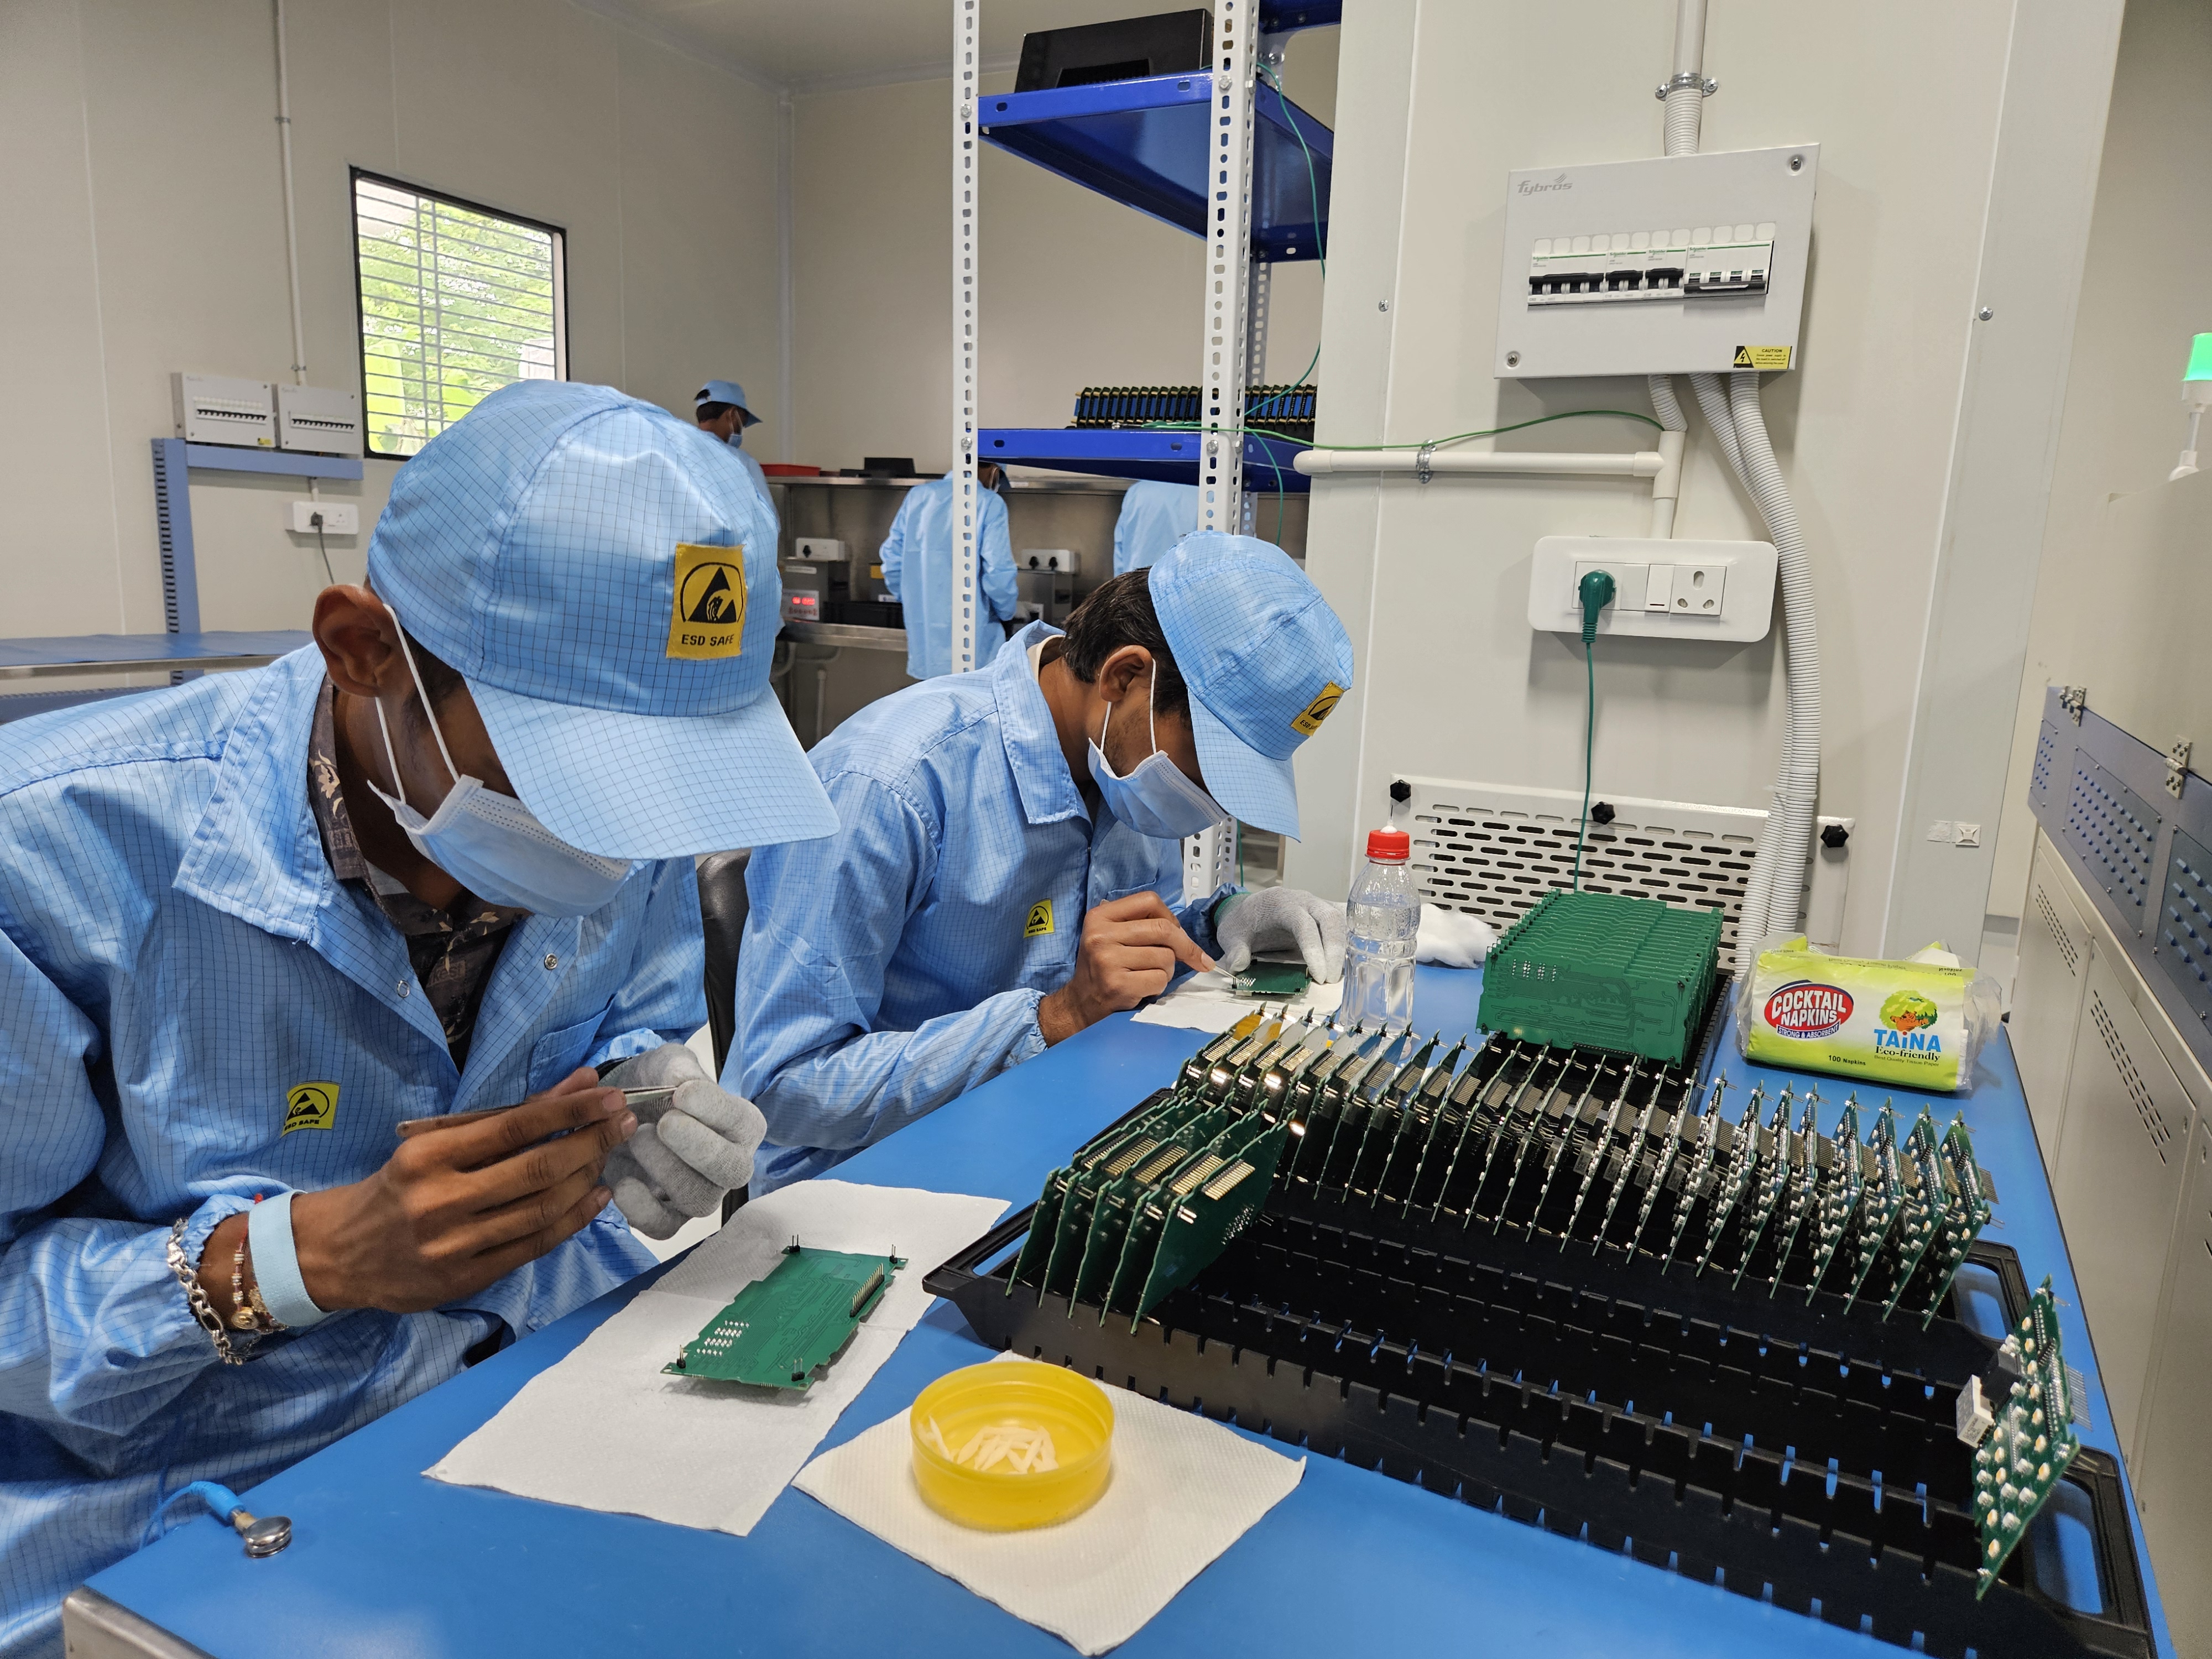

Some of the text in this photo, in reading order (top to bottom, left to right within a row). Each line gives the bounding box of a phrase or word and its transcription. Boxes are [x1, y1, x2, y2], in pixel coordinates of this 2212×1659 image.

[1517, 180, 1573, 196] fybros
[681, 634, 734, 646] ESD SAFE
[1300, 719, 1311, 728] ESD
[1771, 990, 1846, 1020] COCKTAIL
[1781, 1009, 1838, 1027] NAPKINS
[1778, 1027, 1801, 1038] STRONG
[1806, 1025, 1839, 1038] ABSORBENT
[1875, 1046, 1940, 1062] Eco-friendly
[284, 1121, 296, 1131] ESD
